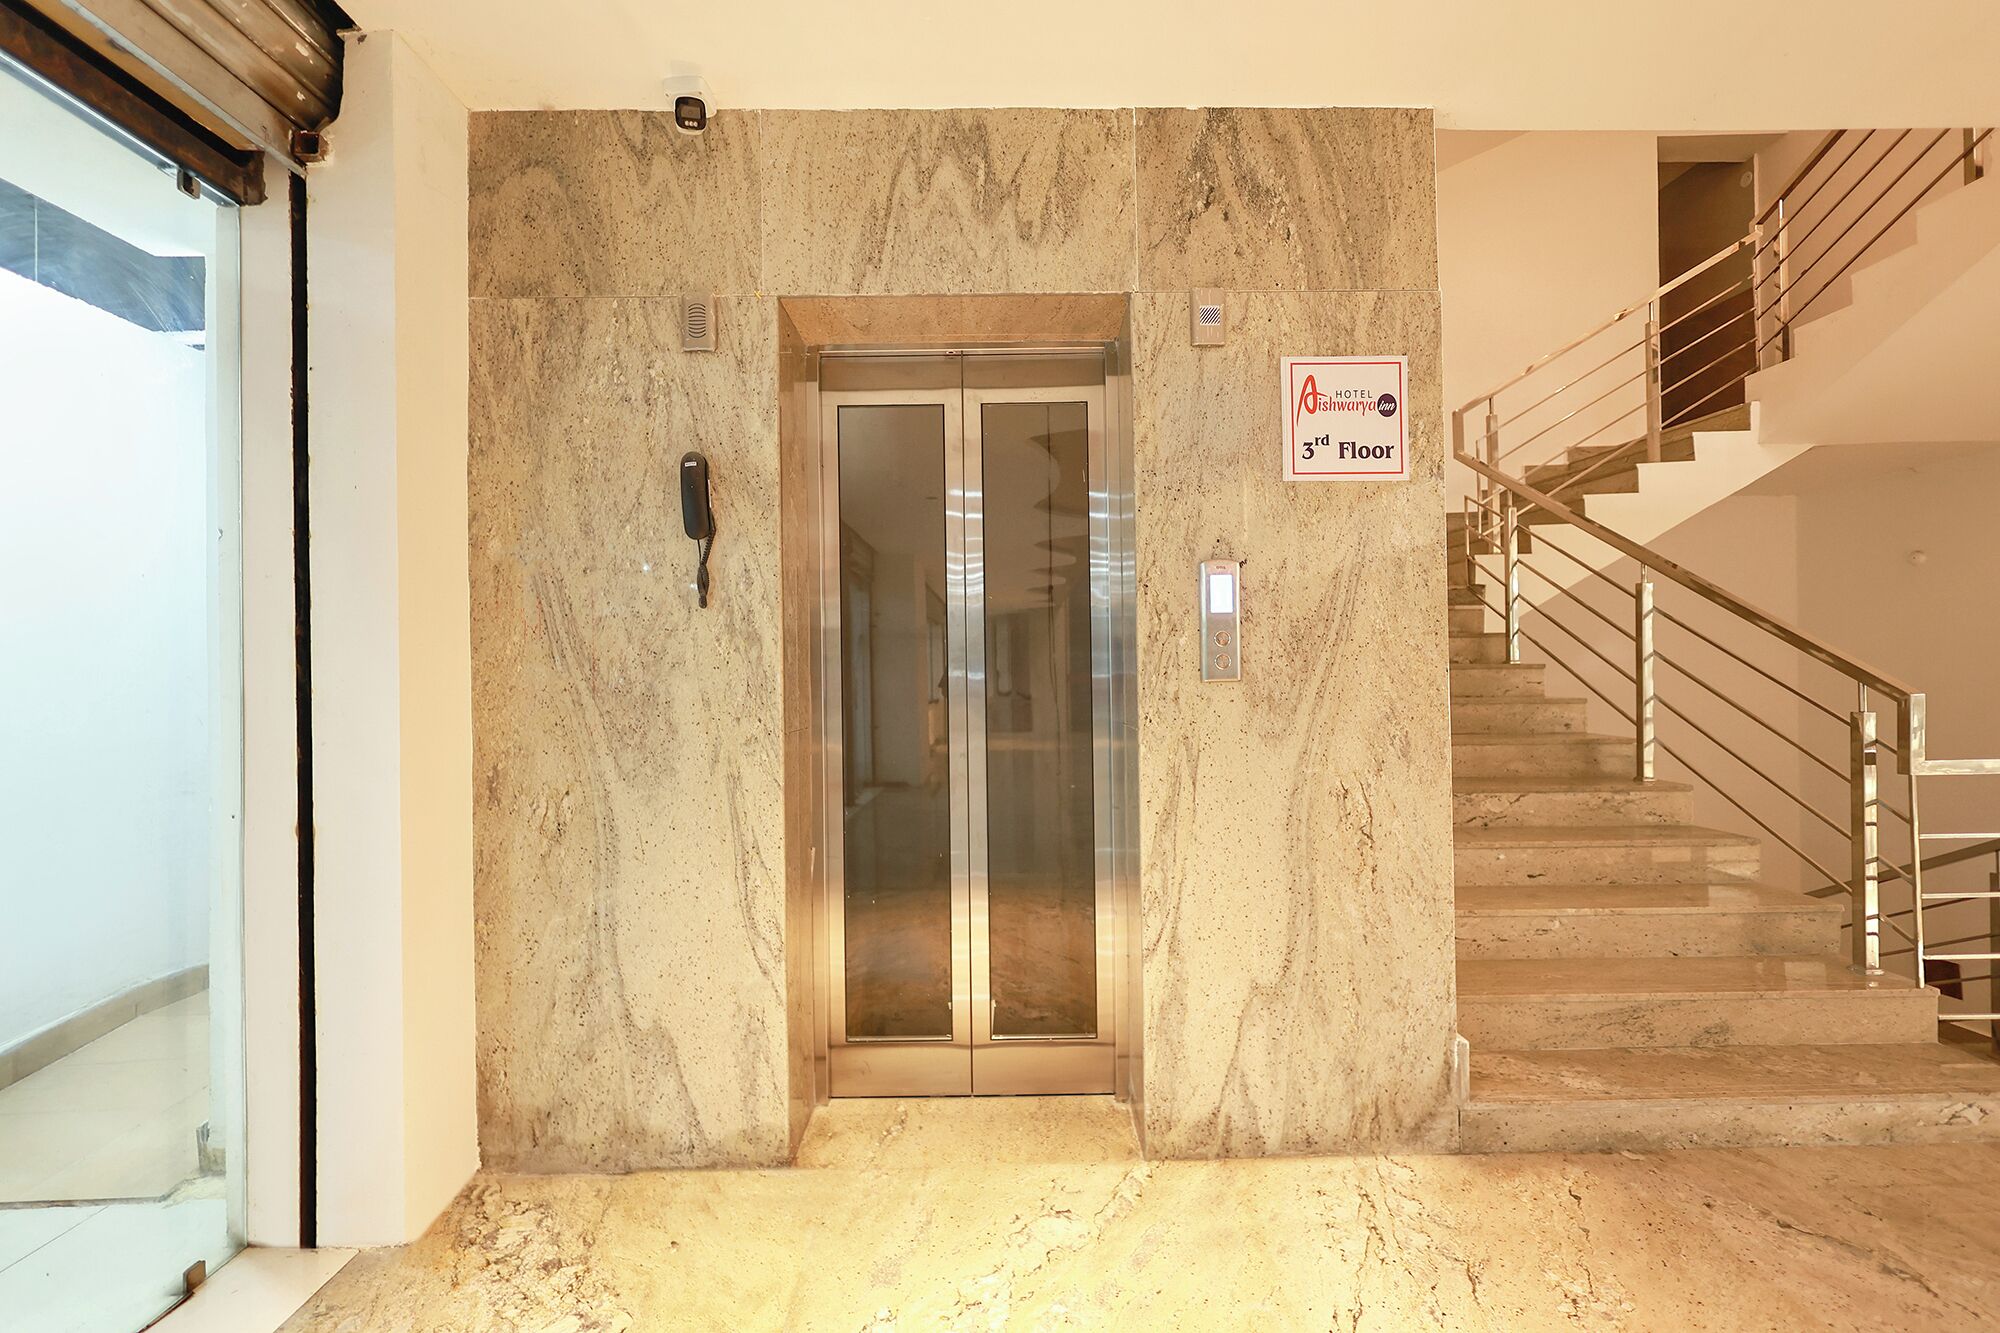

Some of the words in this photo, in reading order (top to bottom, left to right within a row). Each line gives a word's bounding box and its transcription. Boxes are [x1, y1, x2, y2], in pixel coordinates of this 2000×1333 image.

[1296, 374, 1377, 427] Aishwarya
[1335, 390, 1373, 399] HOTEL
[1301, 434, 1330, 460] 3rd
[1338, 441, 1395, 459] Floor
